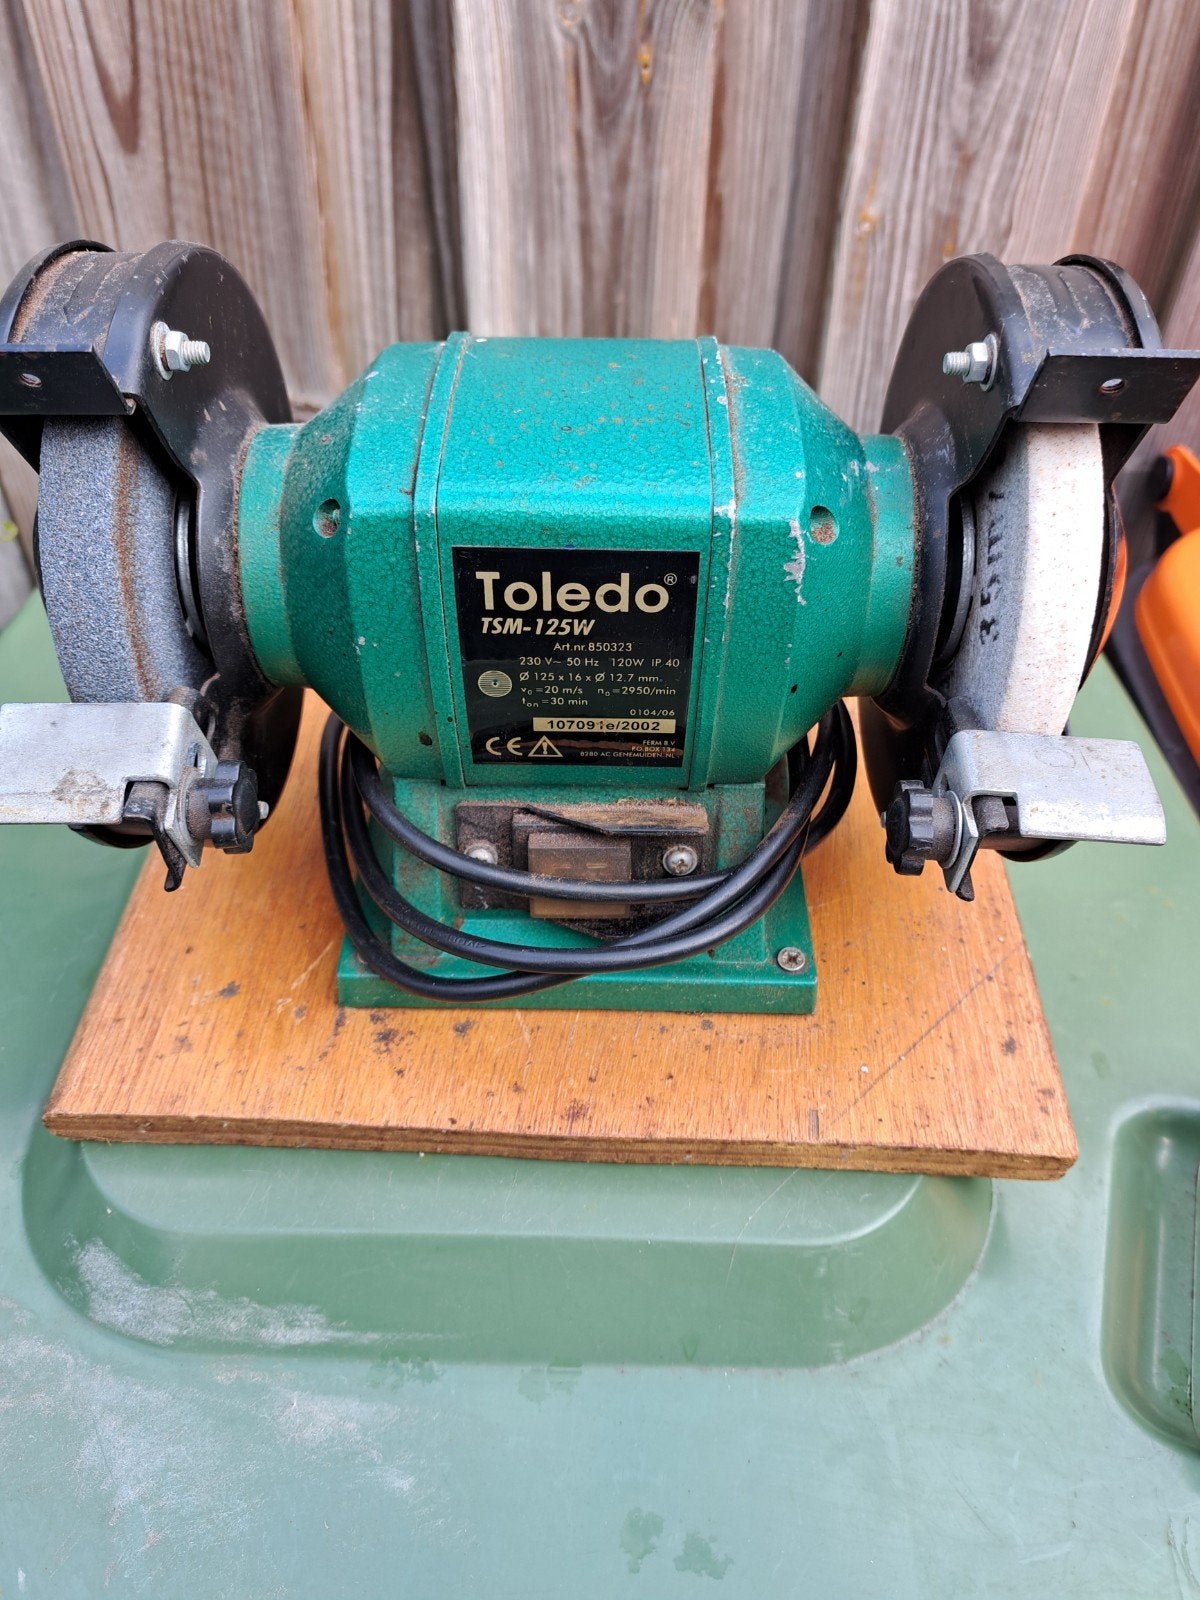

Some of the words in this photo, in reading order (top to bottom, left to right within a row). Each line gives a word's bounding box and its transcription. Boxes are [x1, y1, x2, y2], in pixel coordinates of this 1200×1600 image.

[481, 617, 596, 636] TSM-125W
[519, 656, 542, 666] 230
[566, 657, 581, 667] 50
[584, 658, 600, 667] Hz
[612, 658, 645, 667] 120W
[651, 658, 662, 668] IP
[665, 658, 680, 668] 40
[534, 672, 555, 682] 125
[568, 673, 582, 682] 16
[610, 673, 634, 682] 12.7
[562, 686, 583, 695] m/s
[568, 698, 588, 706] min
[629, 708, 675, 717] 0104/06
